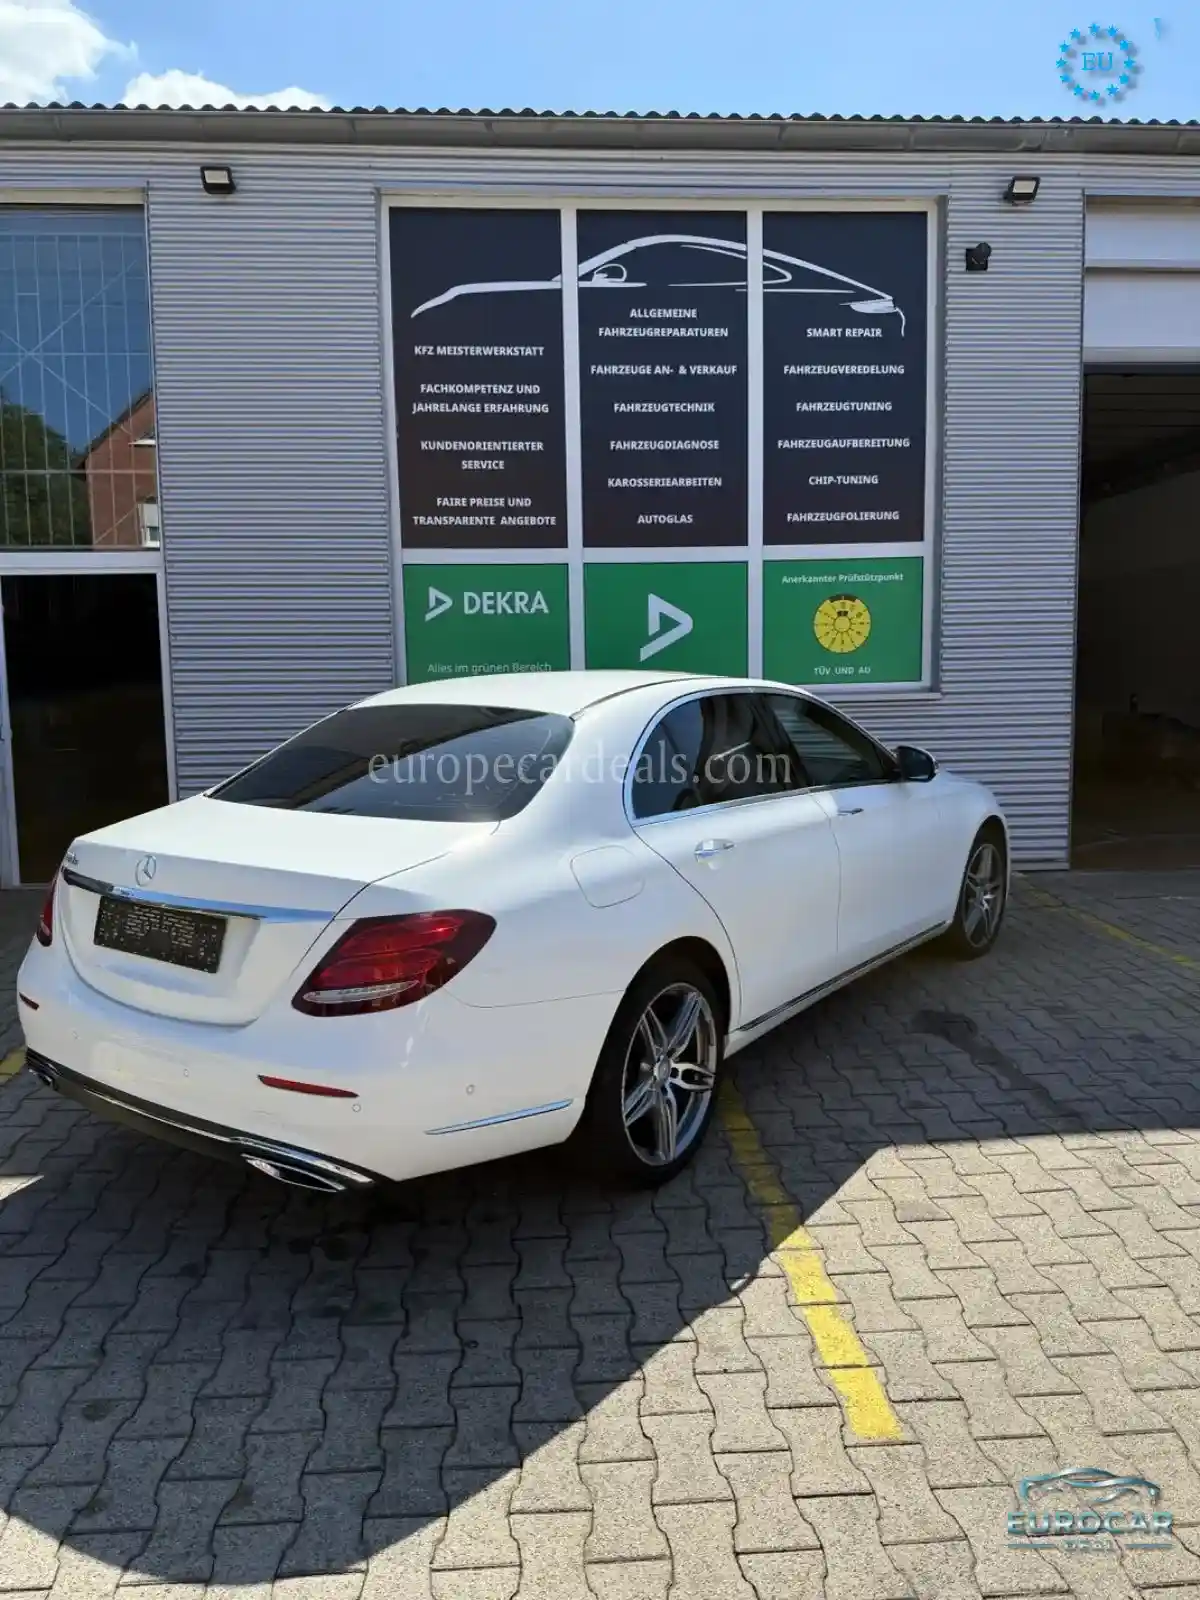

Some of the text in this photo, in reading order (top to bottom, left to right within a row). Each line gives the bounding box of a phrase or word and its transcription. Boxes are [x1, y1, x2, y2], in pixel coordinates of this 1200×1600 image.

[629, 308, 698, 319] ALLGEMEINE
[598, 327, 728, 337] FAHRZEUGREPARATUREN
[806, 328, 883, 338] SMART REPAIR
[414, 345, 544, 356] KFZ MEISTERWERKSTATT
[590, 365, 738, 375] FAHRZEUGE AN- & VERKAUF
[783, 365, 905, 375] FAHRZEUGVEREDELUNG
[420, 383, 541, 394] FACHKOMPETENZ UND
[411, 402, 550, 415] JAHRELANGE ERFAHRUNG
[613, 402, 716, 413] FAHRZEUGTECHNIK
[796, 402, 893, 411] FAHRZEUGTUNING
[420, 440, 544, 451] KUNDENORIENTIERTER
[609, 440, 720, 450] FAHRZEUGDIAGNOSE
[777, 438, 911, 449] FAHRZEUGAUFBEREITUNG
[461, 460, 505, 470] SERVICE
[607, 477, 722, 488] KAROSSERIEARBEITEN
[808, 475, 879, 485] CHIP-TUNING
[436, 497, 532, 508] FAIRE PREISE UND
[412, 515, 557, 526] TRANSPARENTE ANGEBOTE
[637, 514, 694, 524] AUTOGLAS
[787, 511, 900, 522] FAHRZEUGFOLIERUNG
[781, 572, 904, 586] Anerkannter Prüfstützpunkt
[463, 590, 549, 615] DEKRA
[427, 662, 552, 675] Alles im grünen Bereich
[814, 666, 830, 675] TÜV
[835, 666, 854, 675] UND
